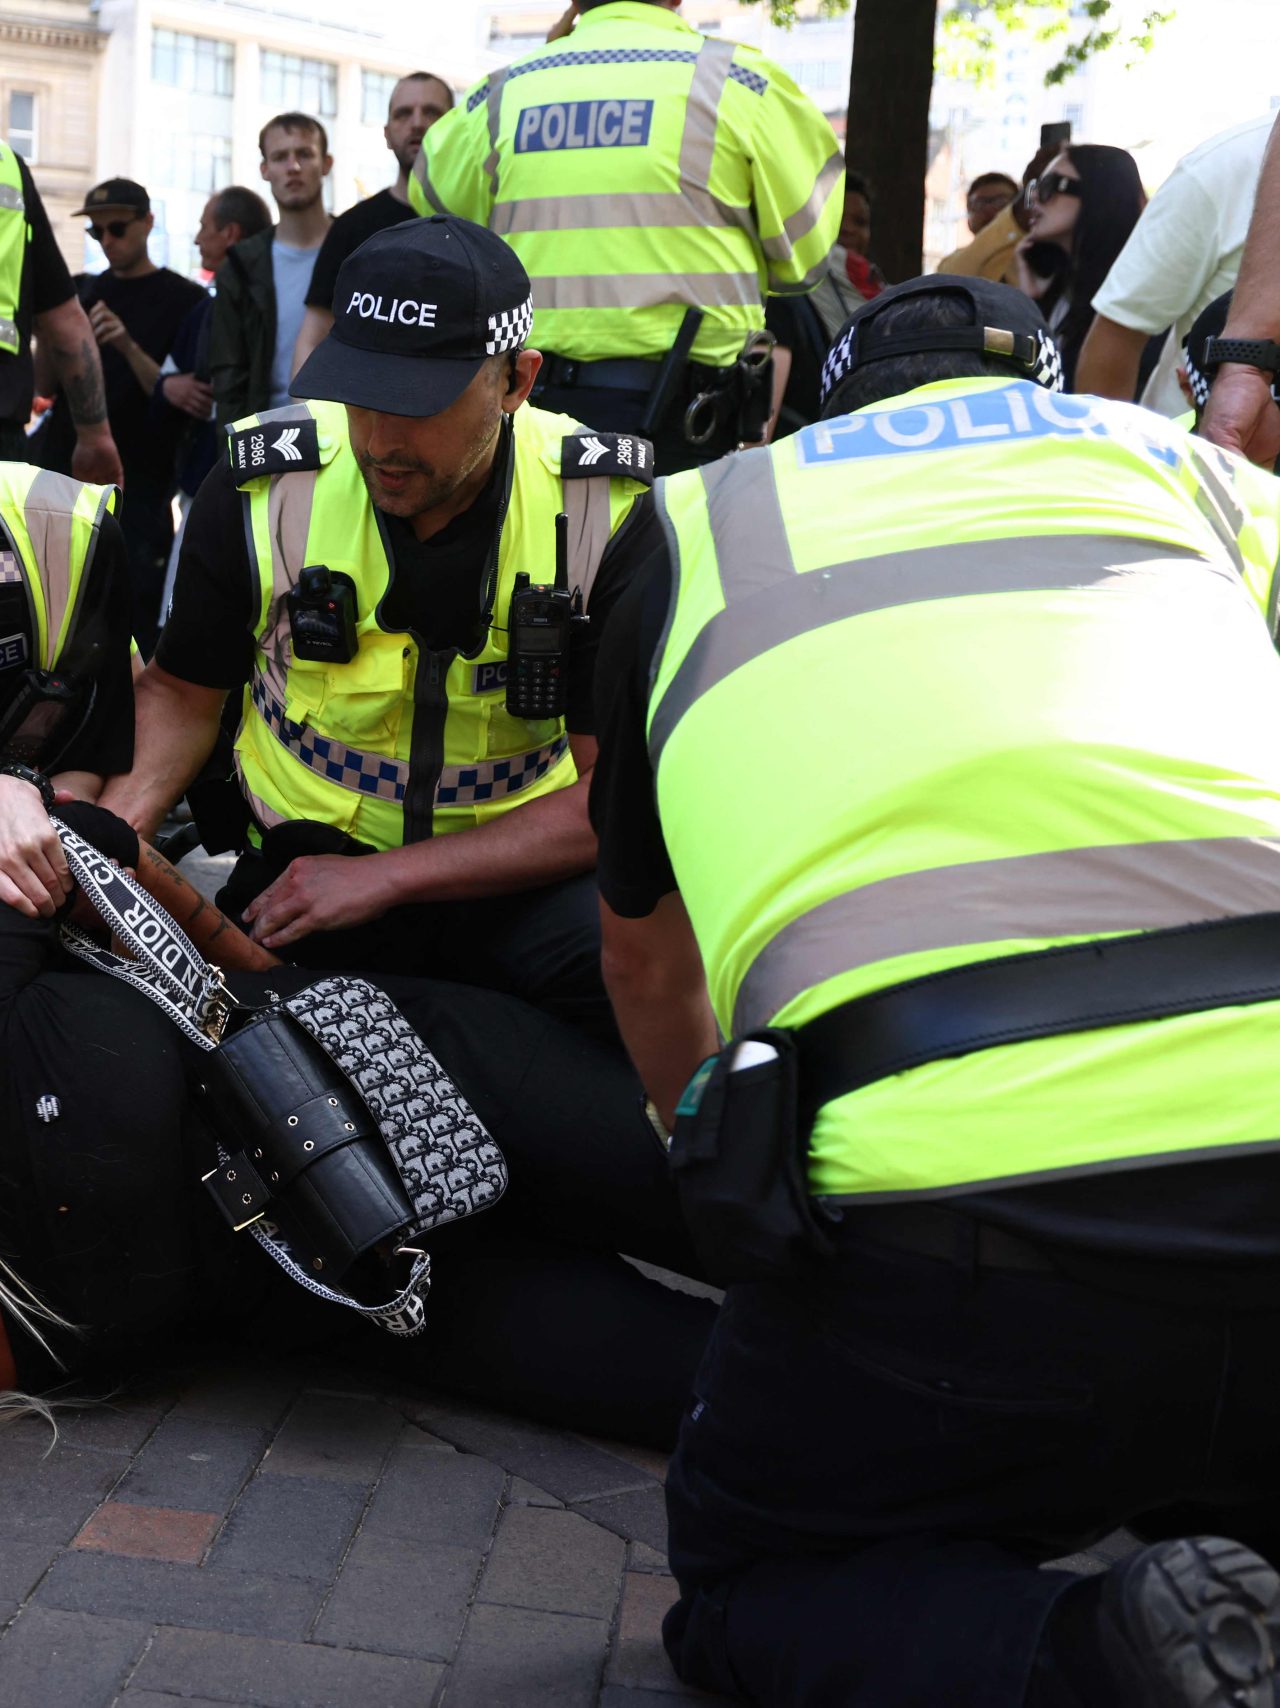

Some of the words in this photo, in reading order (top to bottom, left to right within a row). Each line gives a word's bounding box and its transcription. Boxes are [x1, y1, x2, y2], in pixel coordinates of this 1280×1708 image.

[520, 101, 647, 151] POLICE
[345, 291, 438, 328] POLICE
[814, 388, 1110, 455] POLIC
[250, 433, 266, 466] 2986
[616, 438, 633, 466] 2986
[123, 900, 183, 970] DIOR
